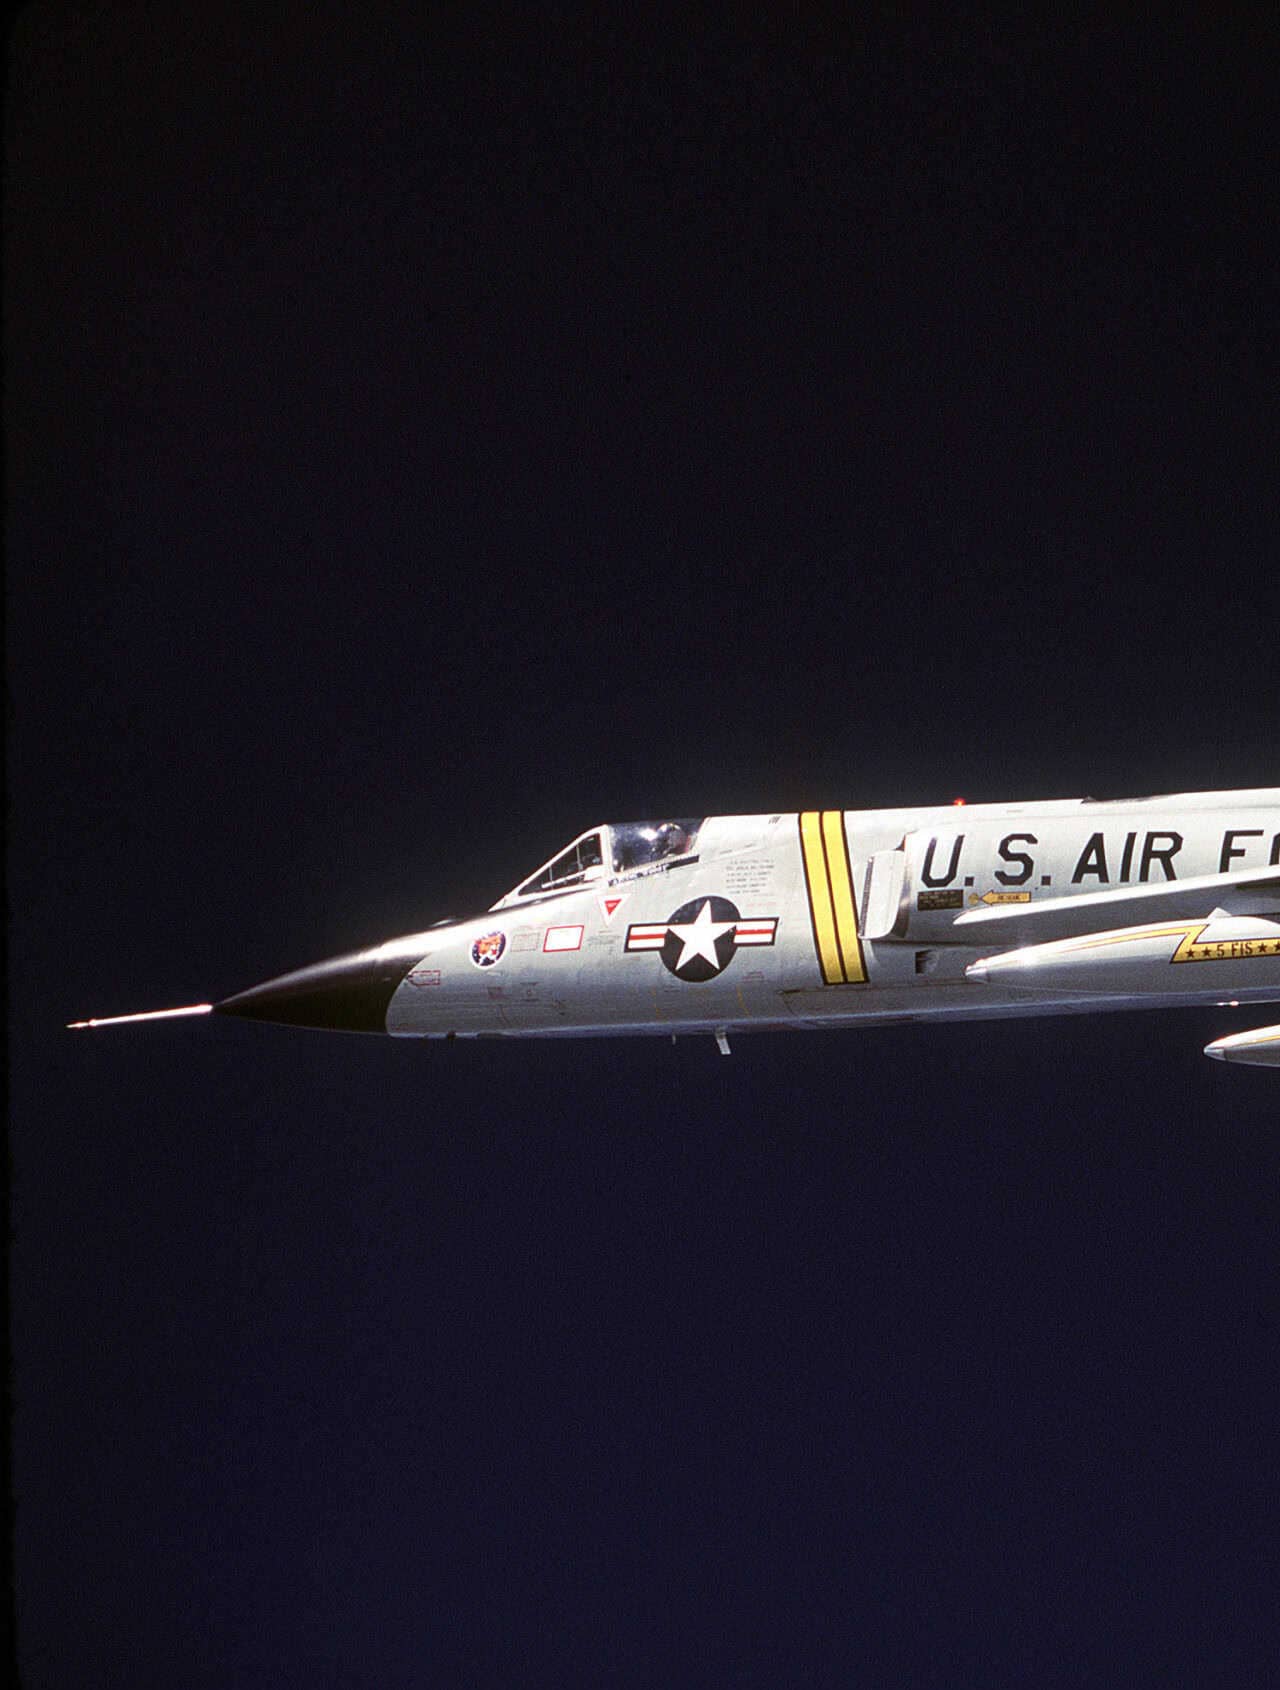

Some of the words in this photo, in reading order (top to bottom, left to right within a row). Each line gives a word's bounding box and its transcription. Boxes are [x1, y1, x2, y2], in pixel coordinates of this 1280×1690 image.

[1071, 831, 1184, 884] AIR
[1216, 944, 1225, 957] 5
[1231, 942, 1254, 956] FIS
